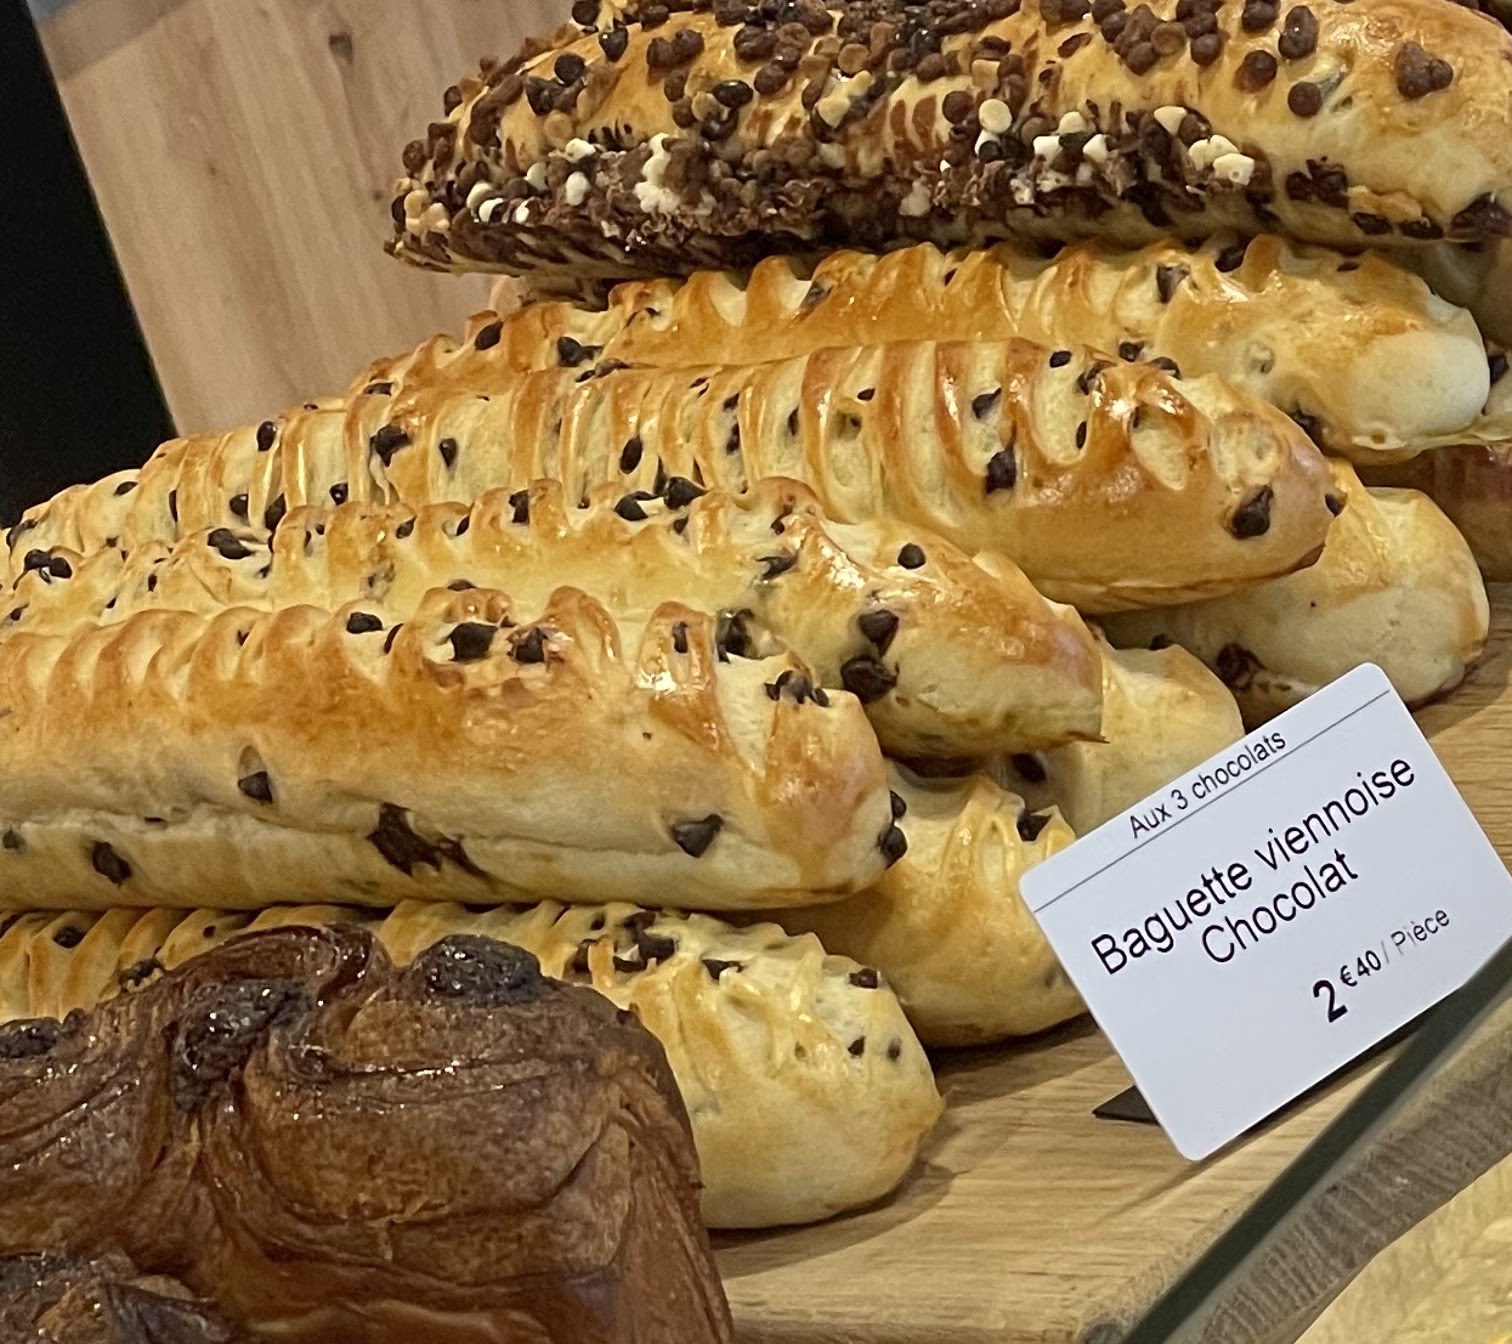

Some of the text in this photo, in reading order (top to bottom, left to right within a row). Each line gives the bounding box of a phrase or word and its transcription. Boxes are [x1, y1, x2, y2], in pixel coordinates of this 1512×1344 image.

[1130, 731, 1287, 839] Aux 3 chocolats
[1090, 758, 1415, 975] Baguette viennoise
[1201, 848, 1359, 963] Chocolat
[1391, 907, 1451, 956] Pièce
